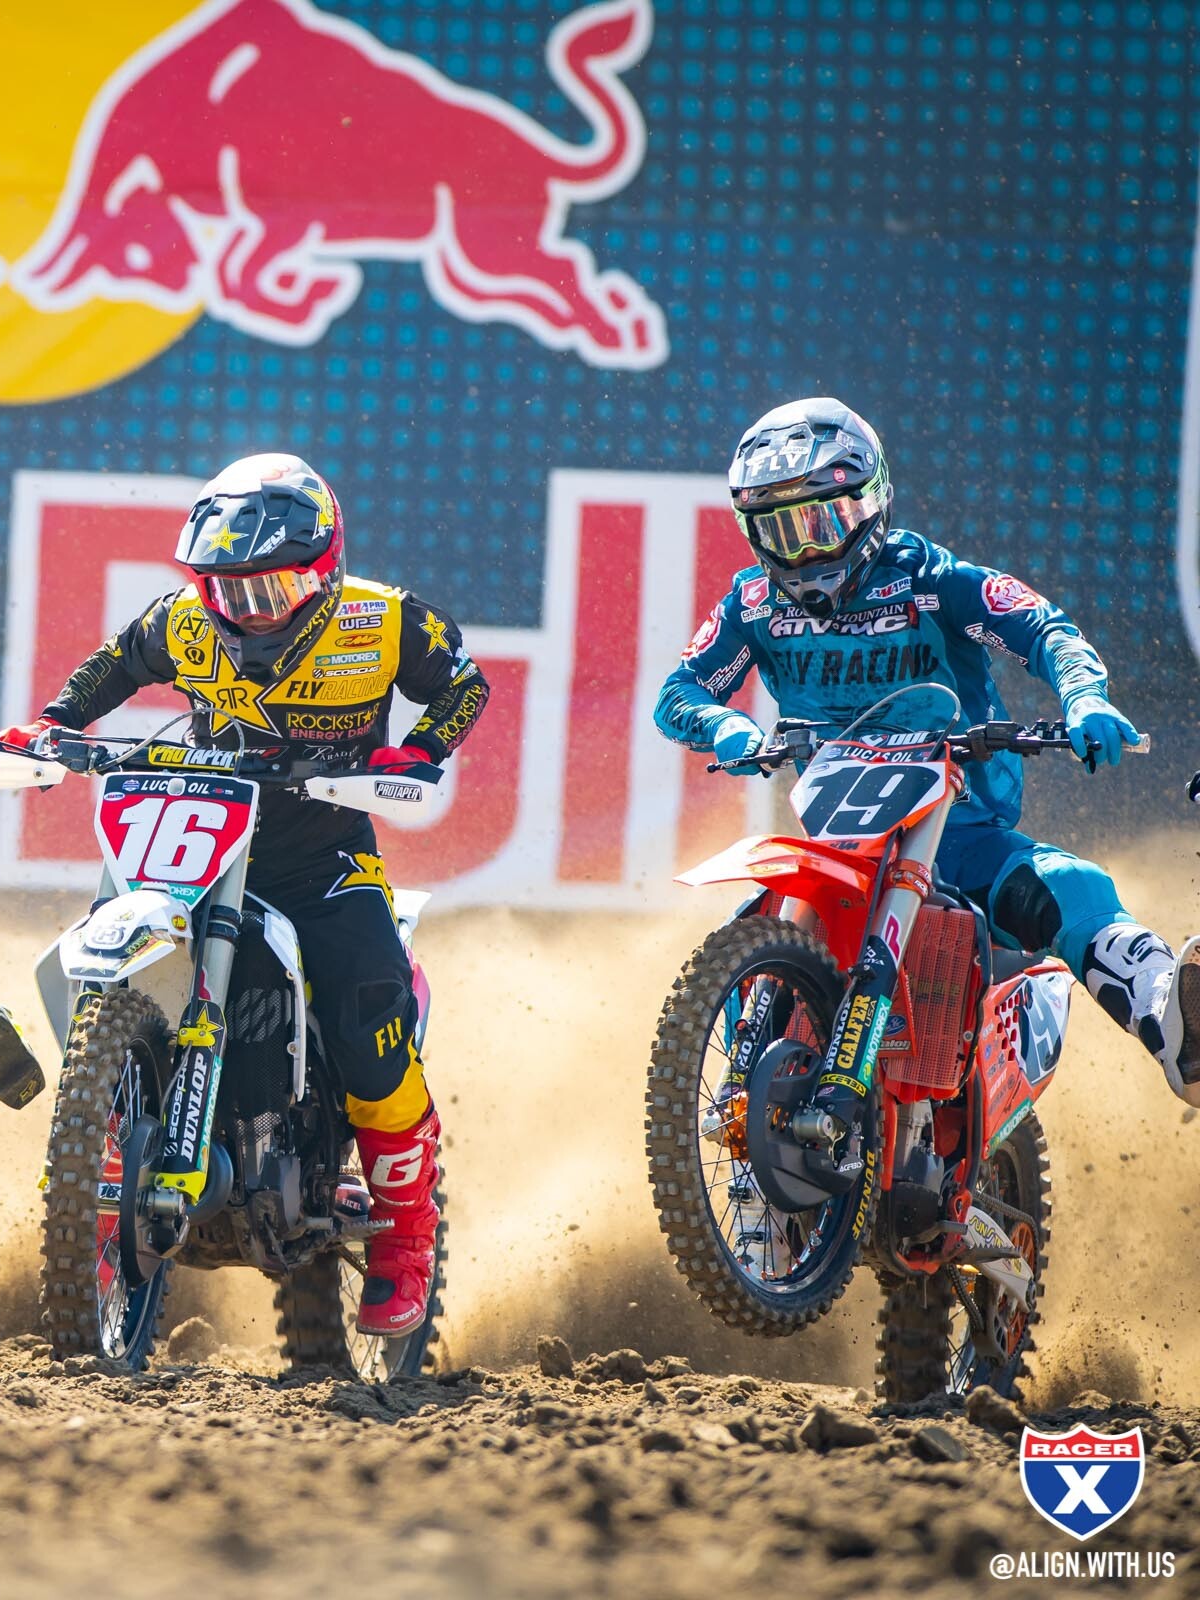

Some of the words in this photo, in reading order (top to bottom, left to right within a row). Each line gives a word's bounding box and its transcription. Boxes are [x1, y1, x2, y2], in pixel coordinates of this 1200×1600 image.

[745, 449, 802, 478] FLY
[336, 602, 369, 616] AMA
[742, 606, 769, 619] GEAR
[834, 602, 905, 624] MOUNTAIN
[339, 615, 383, 631] WPS
[331, 652, 379, 665] MOTOREX
[286, 680, 326, 699] FLY
[290, 729, 344, 741] ENERGY
[842, 747, 888, 762] LUCAS
[891, 751, 913, 763] OIL
[187, 782, 210, 795] OIL
[377, 784, 420, 800] PROTAPER
[800, 765, 940, 837] 19
[118, 797, 229, 883] 16
[864, 1000, 878, 1028] USA
[836, 994, 872, 1070] GALFER
[866, 1002, 890, 1065] MOTOREX
[181, 1052, 208, 1163] DUNLOP
[202, 1060, 223, 1145] MOTOREX
[852, 1149, 876, 1242] DUNLOP
